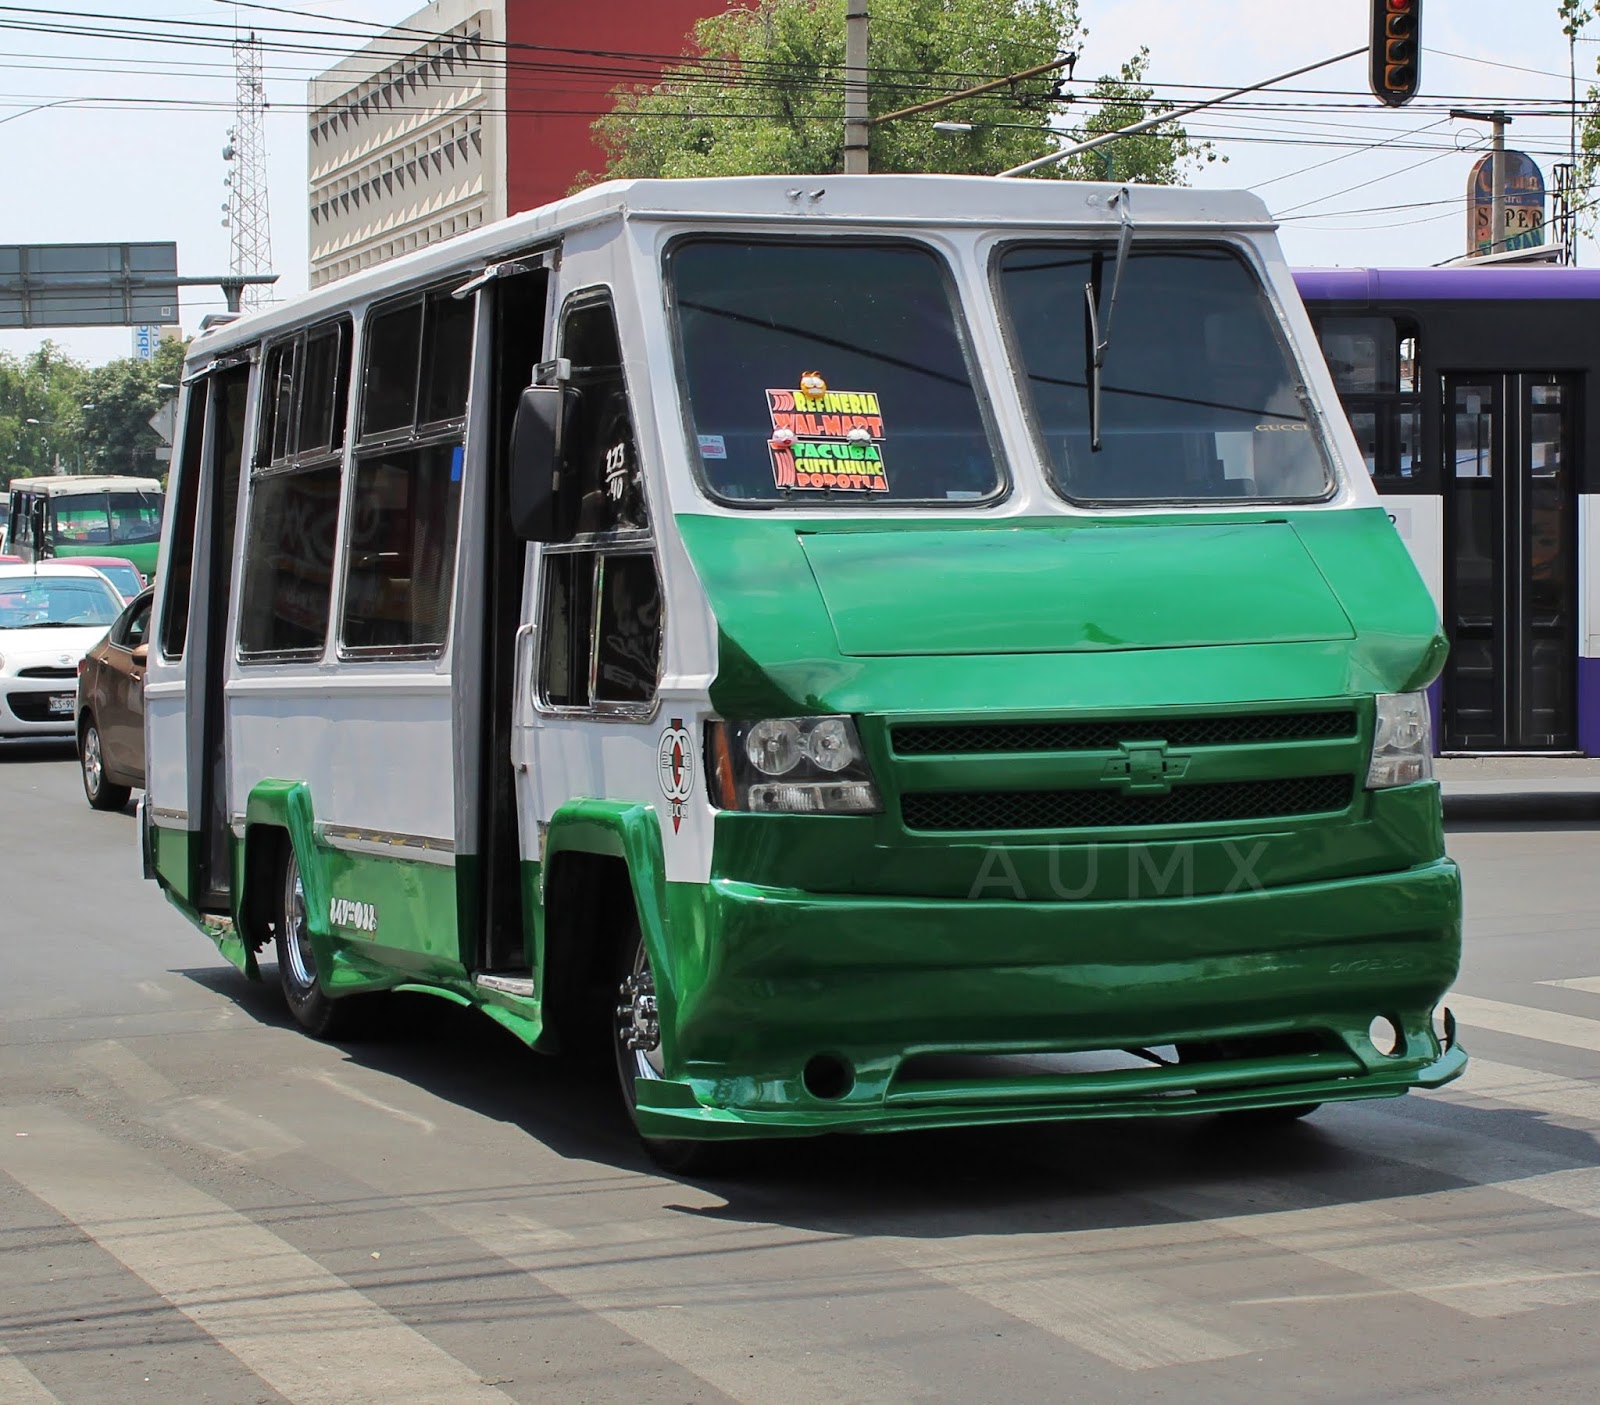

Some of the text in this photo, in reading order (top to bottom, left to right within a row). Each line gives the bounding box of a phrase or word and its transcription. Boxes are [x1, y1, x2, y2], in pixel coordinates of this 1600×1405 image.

[1478, 207, 1543, 229] SPER
[793, 392, 879, 414] REFINERIA
[773, 413, 882, 437] WAL-MART
[1255, 423, 1309, 432] GUCCI
[791, 443, 880, 460] TACUBA
[795, 459, 883, 475] CUITLAHUAC
[797, 473, 887, 489] POPOTLA
